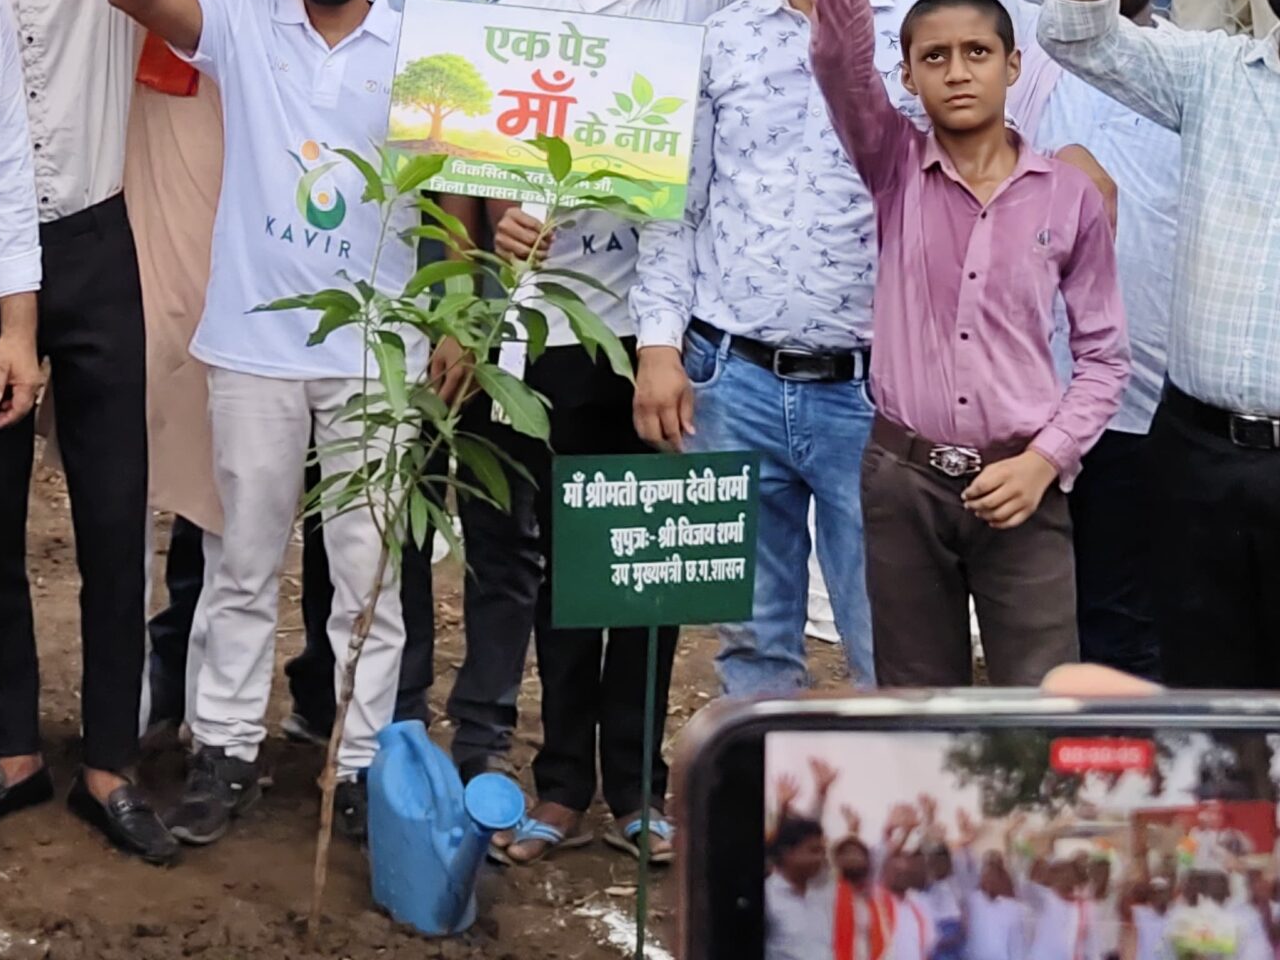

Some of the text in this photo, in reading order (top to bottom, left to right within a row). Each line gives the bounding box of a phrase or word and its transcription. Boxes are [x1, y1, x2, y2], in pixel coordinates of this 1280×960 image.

[483, 21, 610, 78] एक पेड़
[496, 69, 681, 157] माँ के नाम
[265, 215, 351, 259] KAVIR
[563, 465, 751, 513] माँ श्रीमती कृष्णा देवी शर्मा
[658, 517, 677, 548] श्री
[678, 516, 716, 546] विजय
[717, 513, 746, 544] शर्मा
[610, 563, 631, 586] उप
